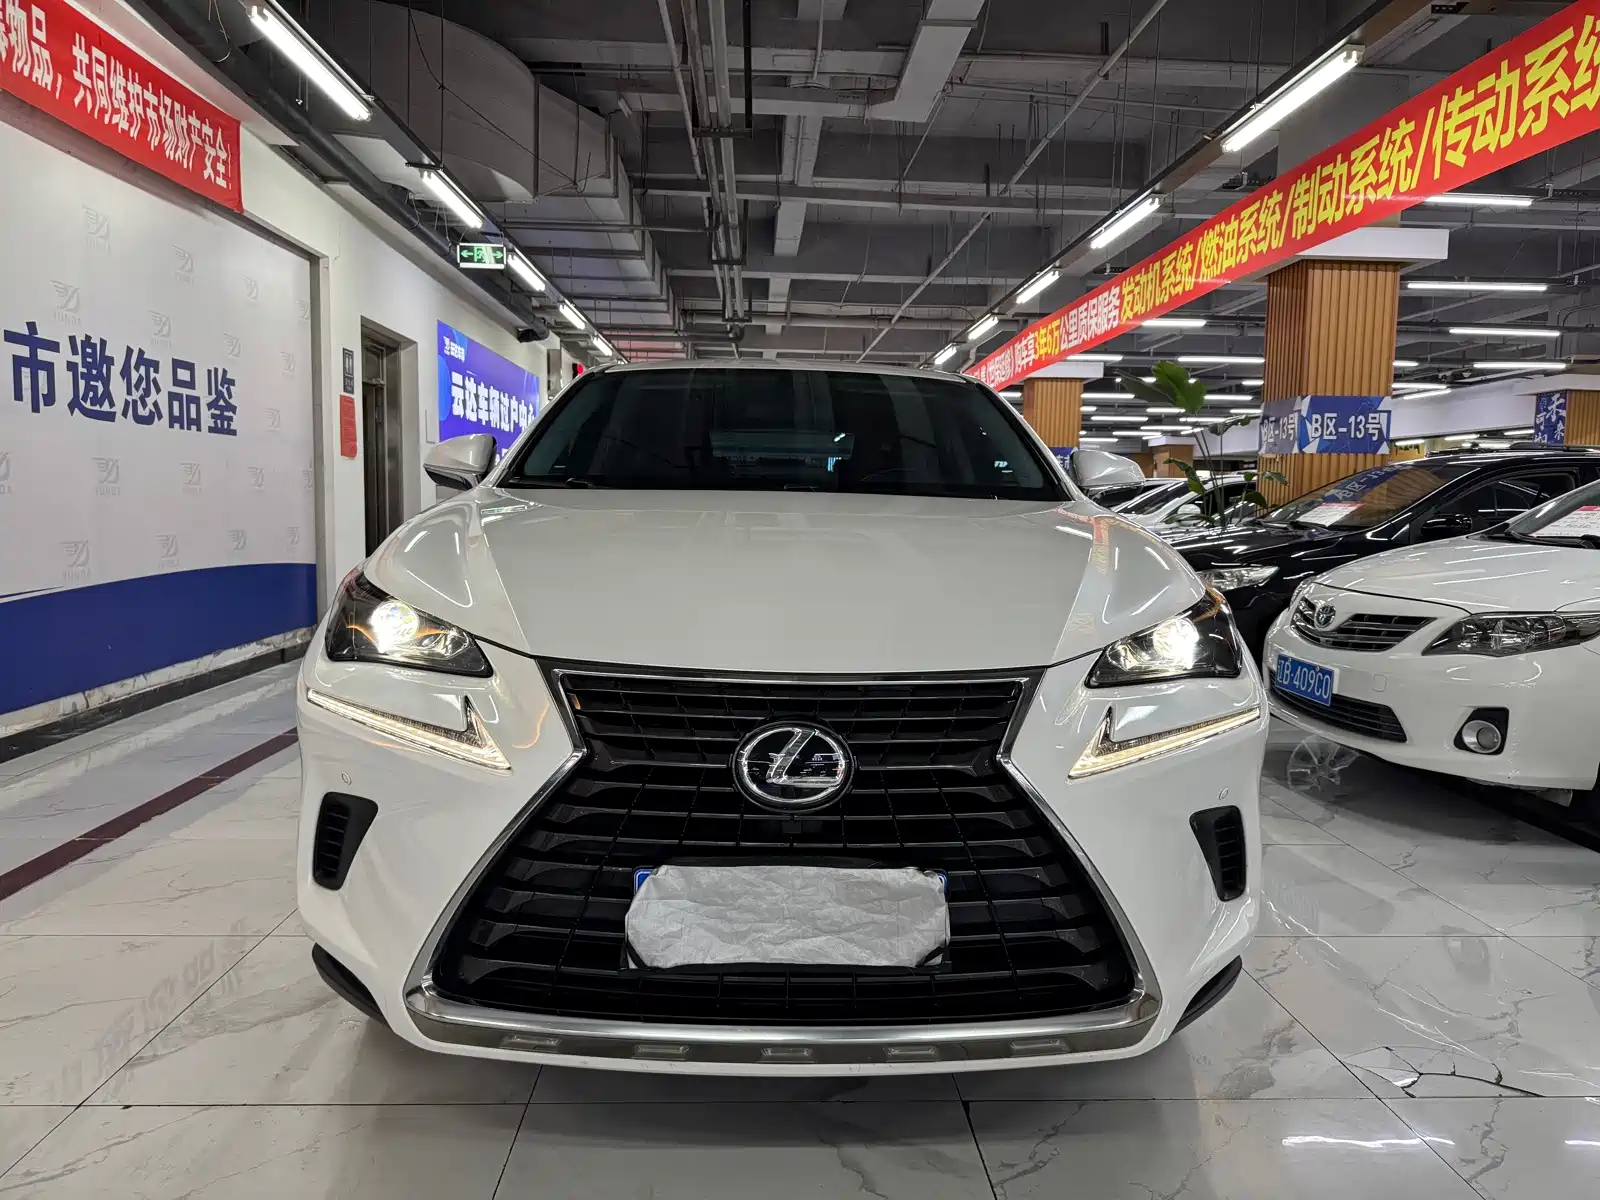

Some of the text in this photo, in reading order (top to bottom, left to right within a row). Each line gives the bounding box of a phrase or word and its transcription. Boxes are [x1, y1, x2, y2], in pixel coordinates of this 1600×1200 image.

[4, 321, 237, 436] 市邀您品鉴
[1311, 412, 1381, 441] B区-13号
